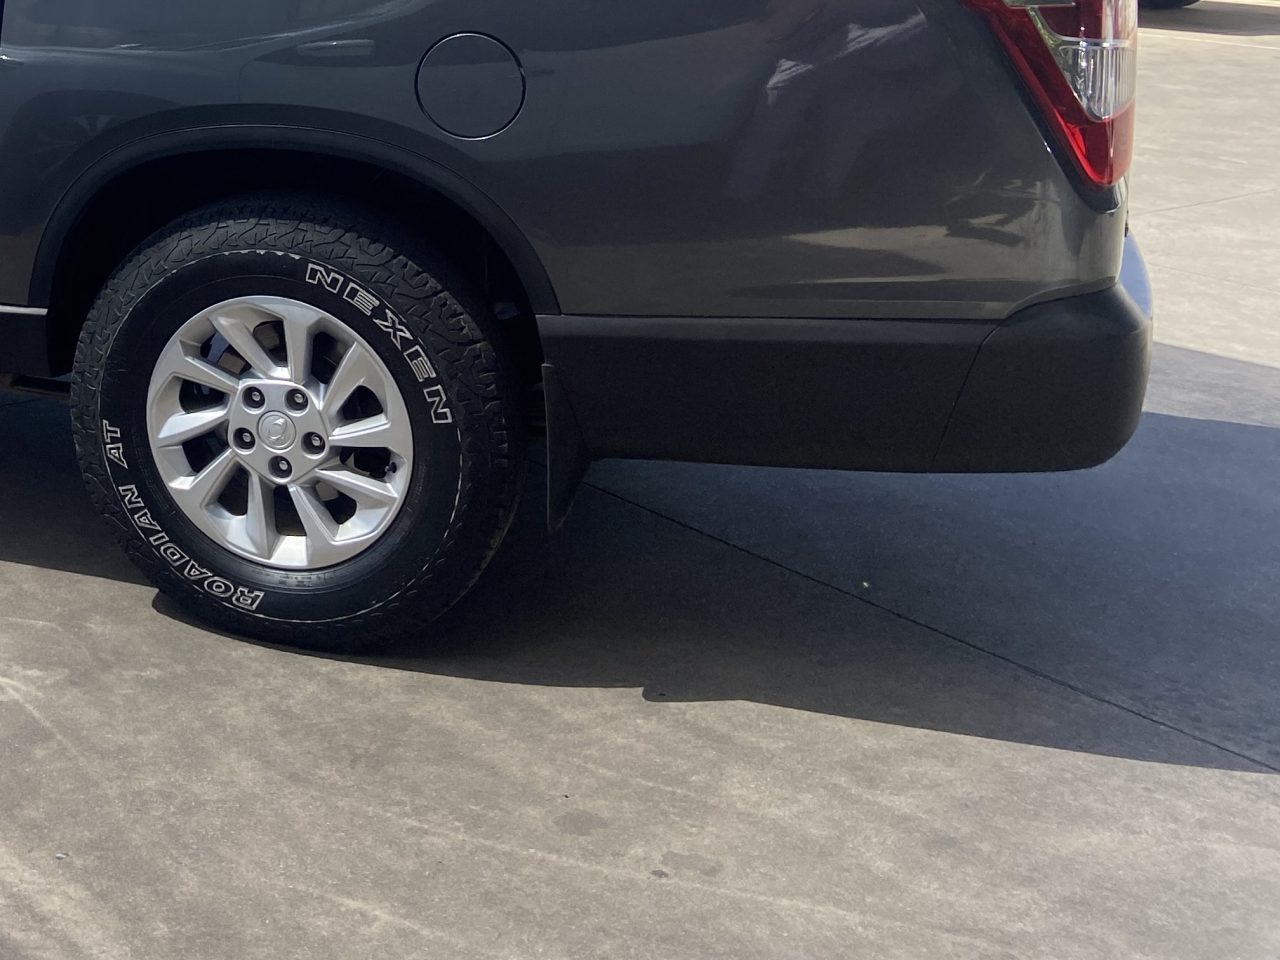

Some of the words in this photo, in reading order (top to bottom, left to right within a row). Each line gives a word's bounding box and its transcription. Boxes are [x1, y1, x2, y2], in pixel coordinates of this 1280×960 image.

[305, 262, 453, 425] NEXEN
[102, 419, 129, 469] AT
[118, 484, 265, 612] ROADIAN
